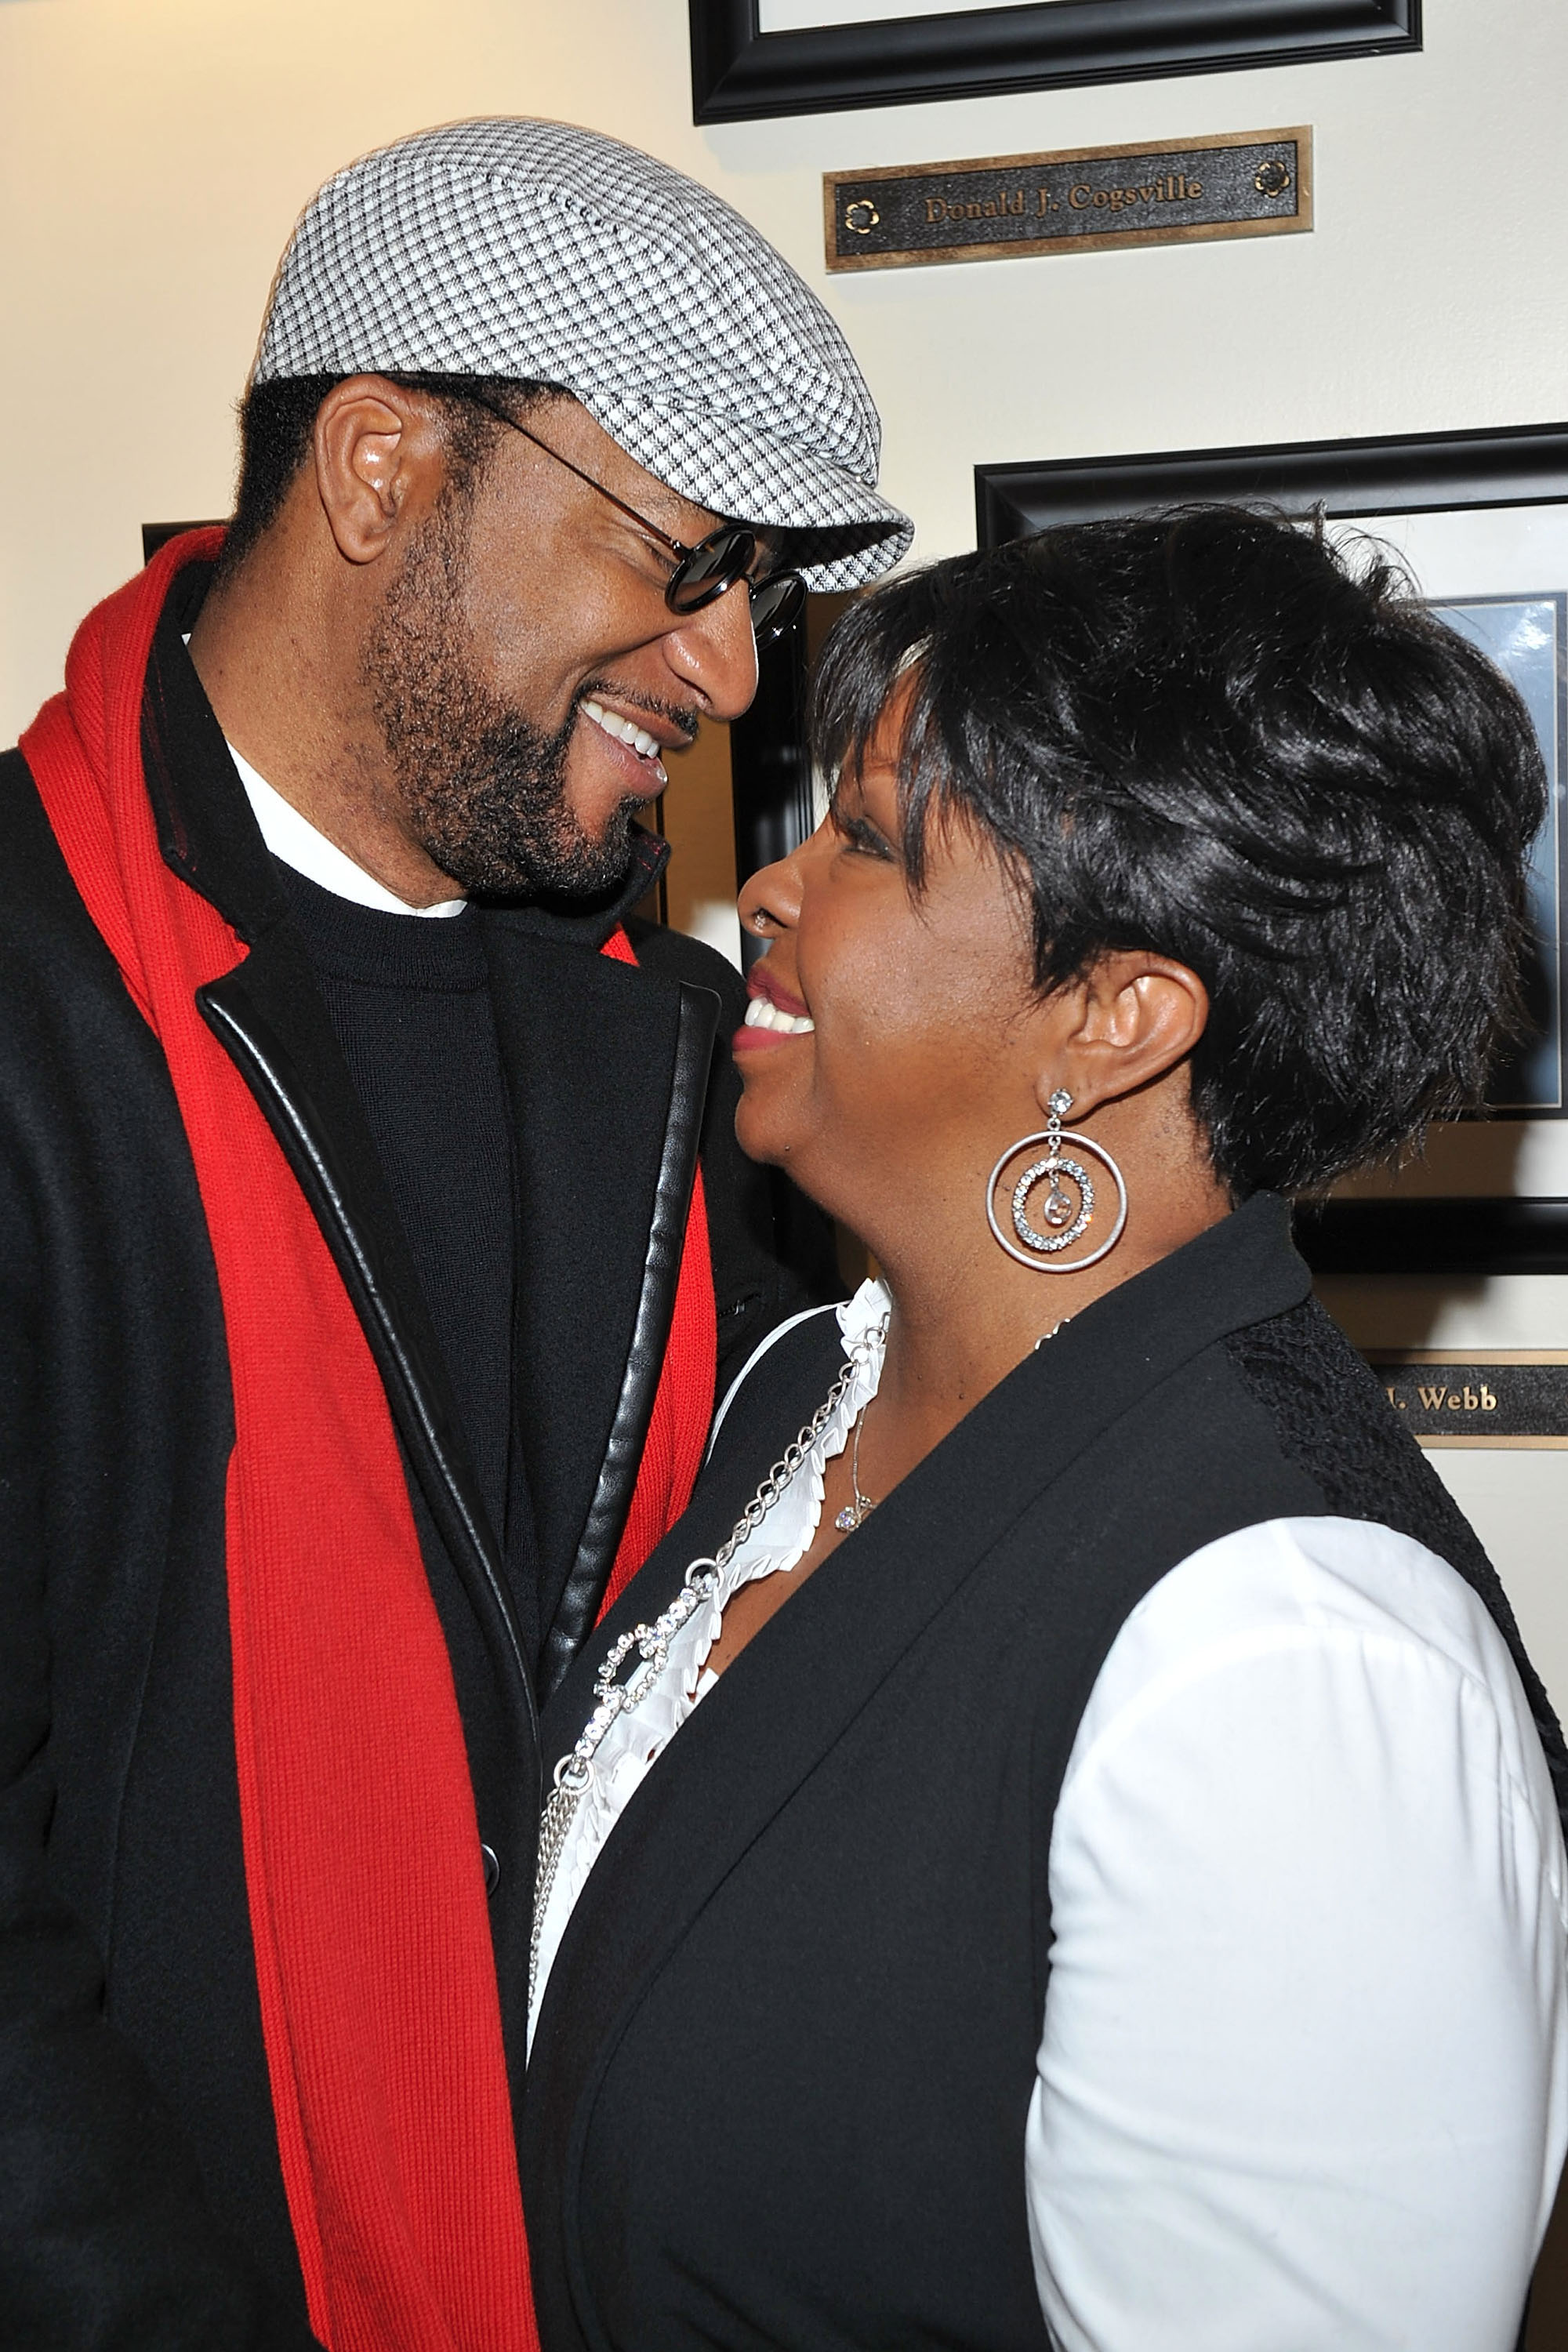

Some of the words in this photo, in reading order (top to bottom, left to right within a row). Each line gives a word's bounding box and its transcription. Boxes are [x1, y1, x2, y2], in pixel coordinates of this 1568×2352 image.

[925, 189, 1025, 223] Donald
[1036, 187, 1059, 218] J.
[1068, 172, 1203, 212] Cogsville
[1417, 1384, 1497, 1410] Webb
